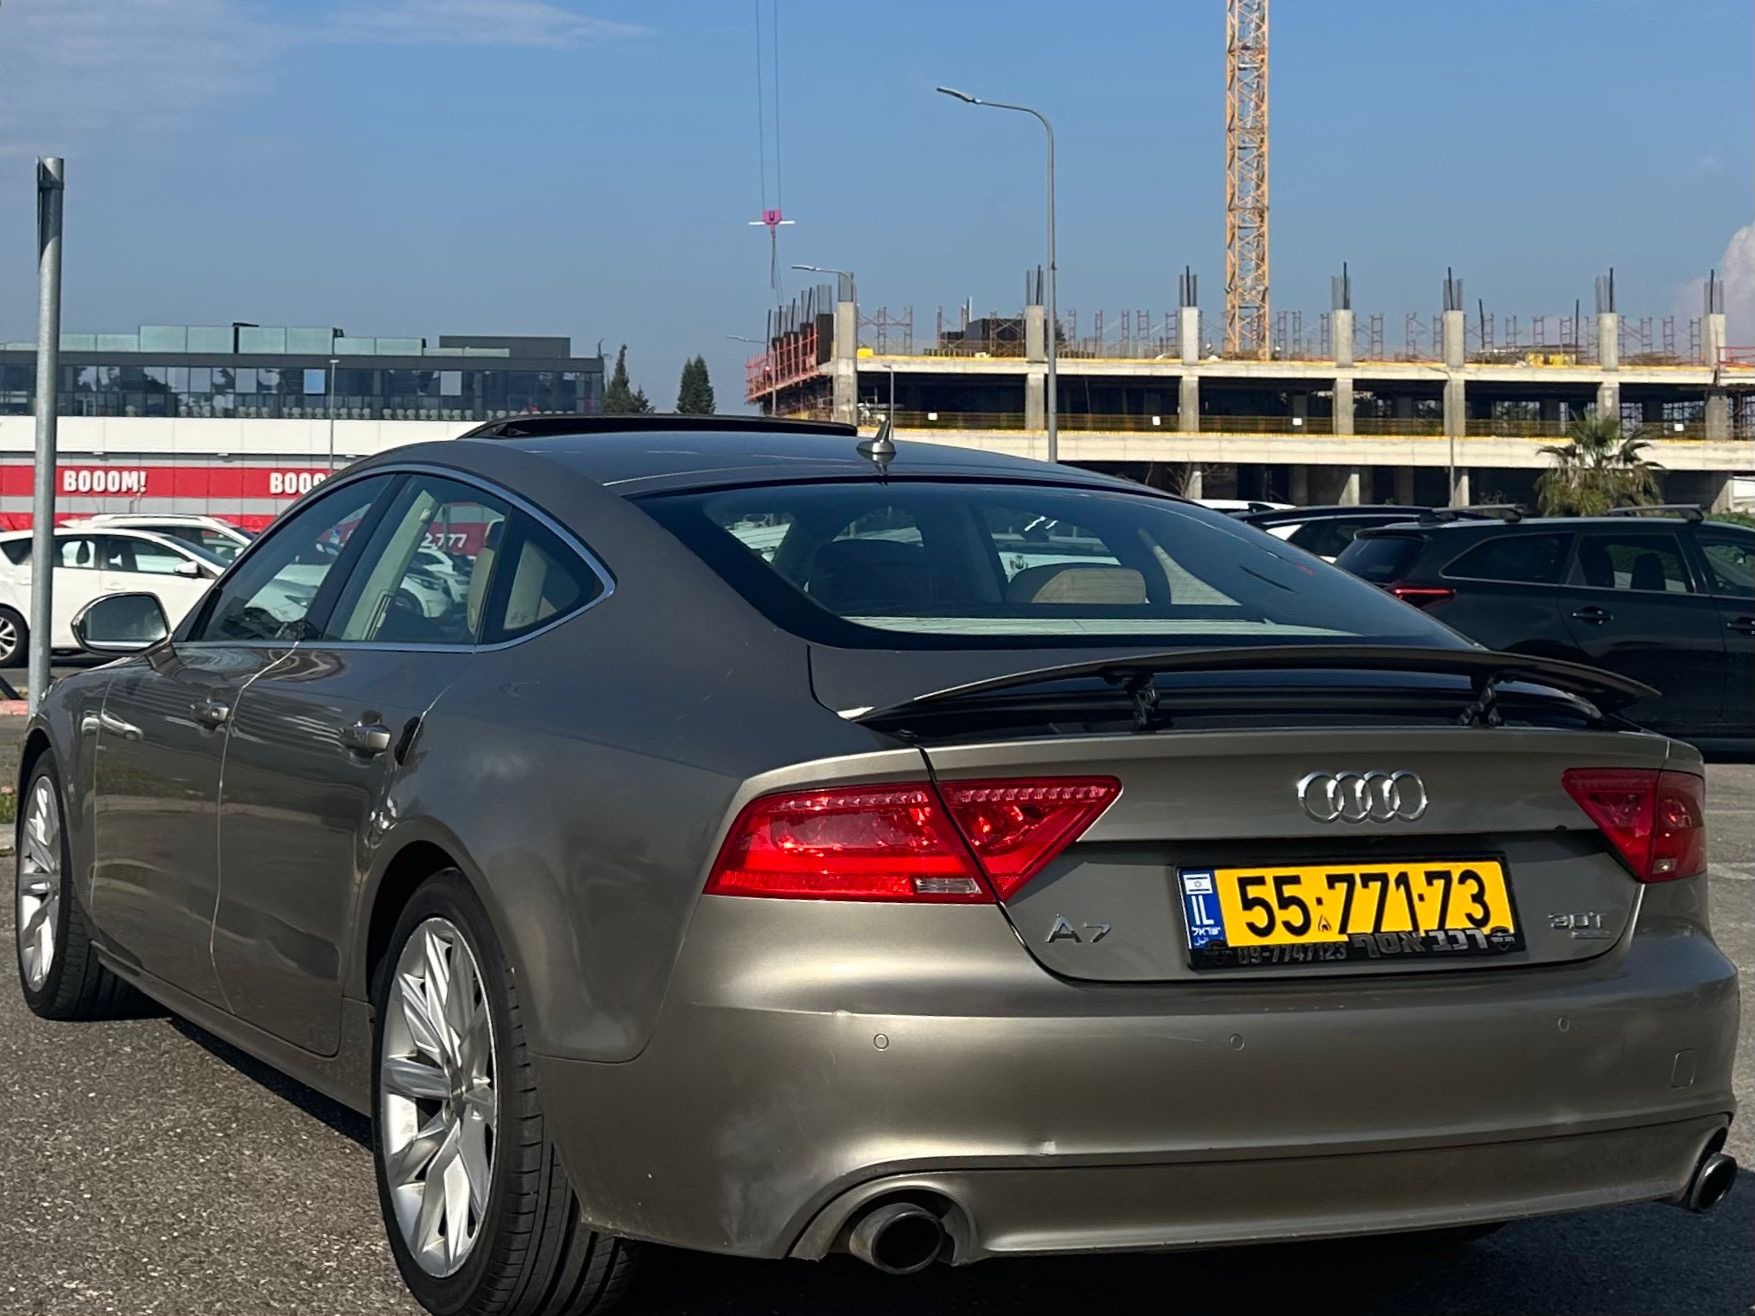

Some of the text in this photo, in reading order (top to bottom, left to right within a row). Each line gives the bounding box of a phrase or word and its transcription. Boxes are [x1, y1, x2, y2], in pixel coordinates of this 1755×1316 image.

[63, 470, 147, 493] BOOOM!
[1191, 895, 1214, 925] IL
[1045, 912, 1112, 943] A7
[1428, 929, 1489, 952] רכב
[1350, 931, 1426, 958] אסף
